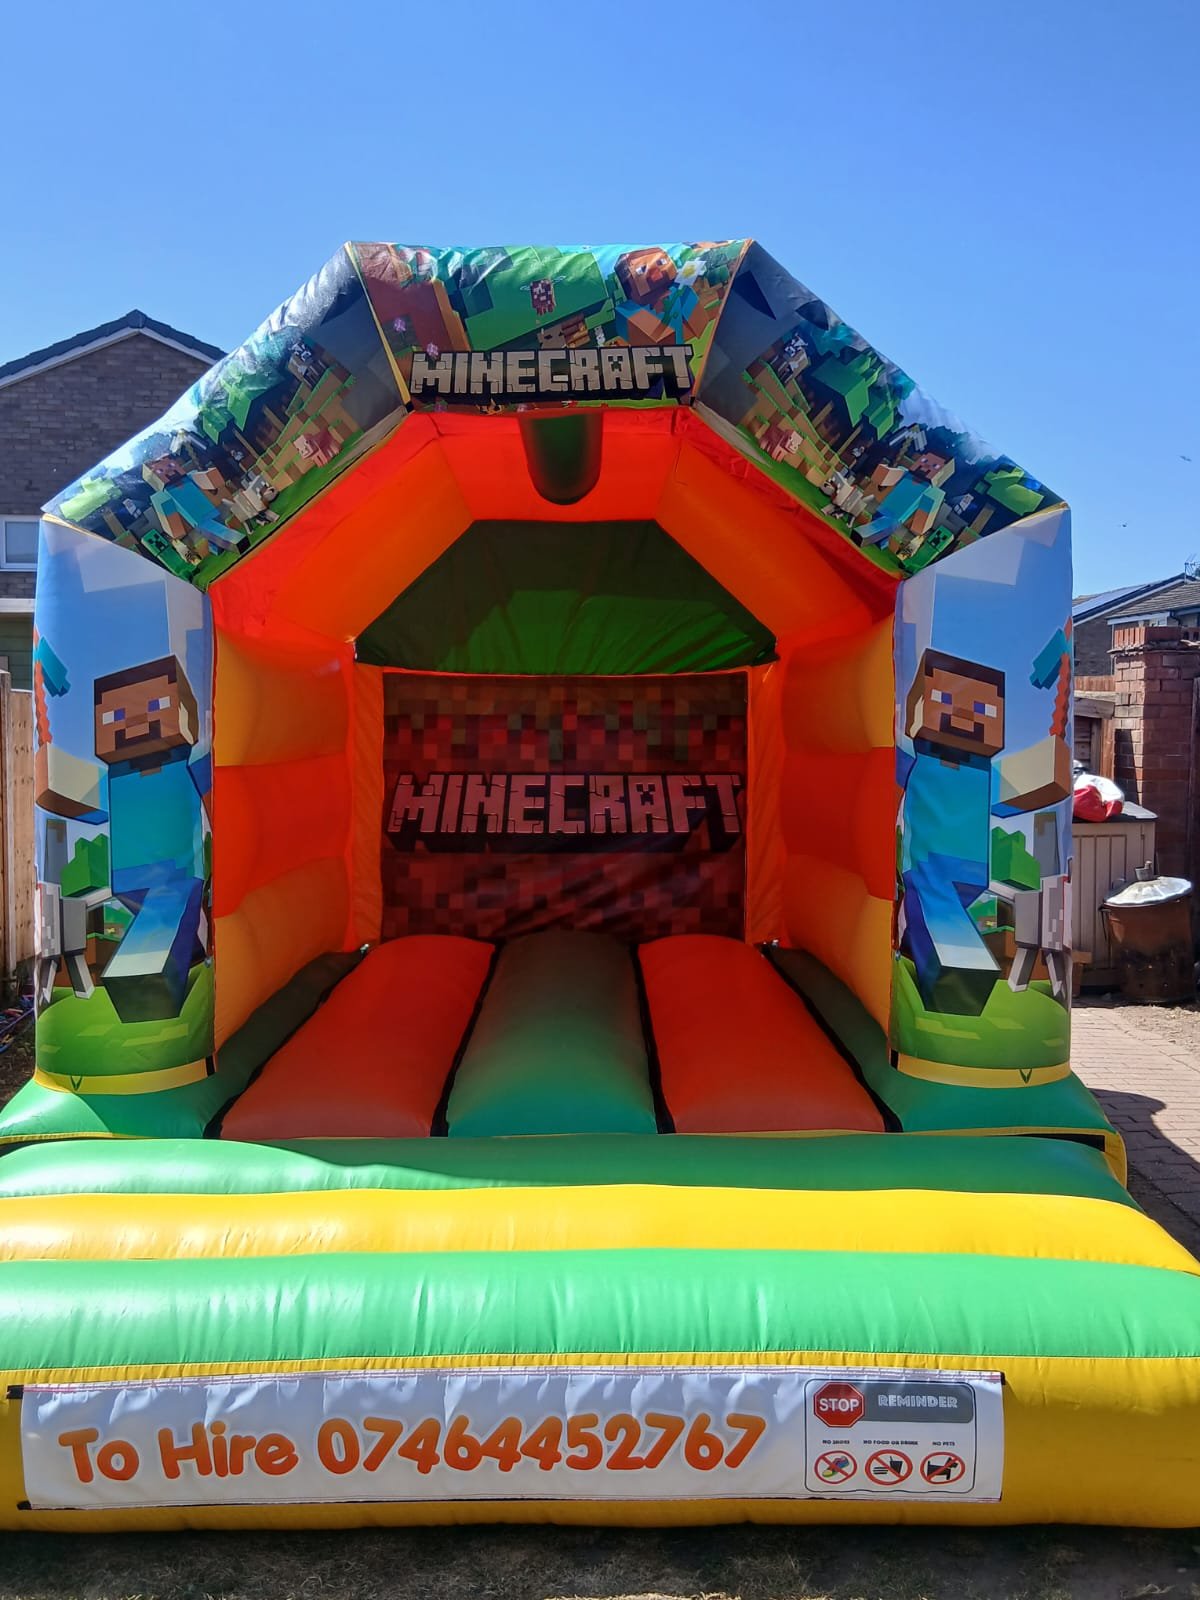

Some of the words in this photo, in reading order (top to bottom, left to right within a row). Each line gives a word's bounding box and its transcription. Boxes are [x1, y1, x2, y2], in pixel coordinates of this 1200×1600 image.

[410, 344, 694, 396] MINECRAFT
[386, 773, 742, 838] MINECRAFT
[819, 1398, 860, 1412] STOP
[877, 1394, 958, 1409] REMINDER
[58, 1429, 139, 1482] To
[158, 1421, 299, 1480] Hire
[317, 1413, 766, 1475] 07464452767
